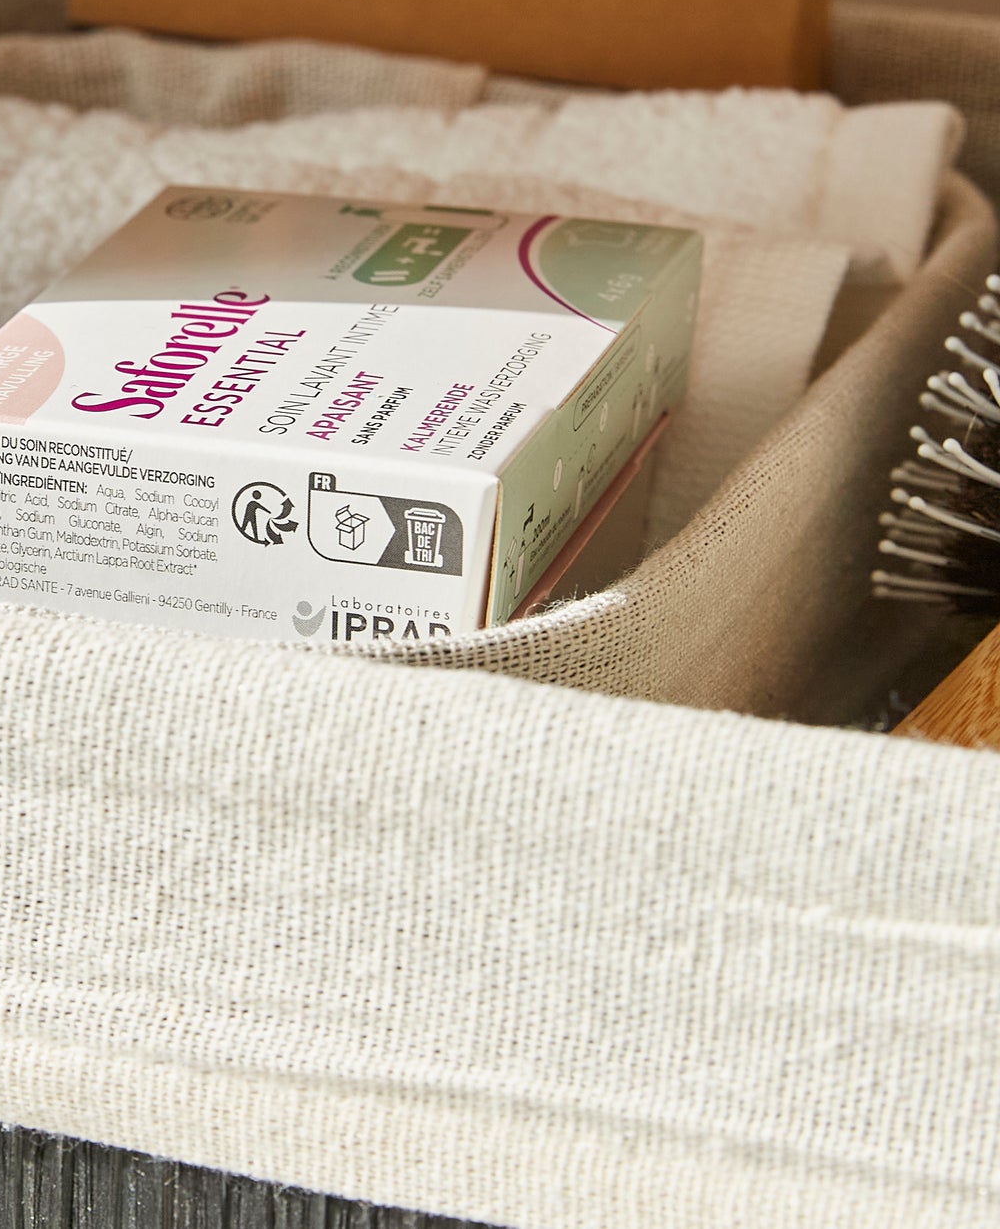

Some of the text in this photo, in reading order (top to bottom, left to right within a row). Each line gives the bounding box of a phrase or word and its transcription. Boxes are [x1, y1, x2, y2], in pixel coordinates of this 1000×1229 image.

[71, 288, 270, 419] Saforelle
[258, 303, 399, 435] SOIN LAVANT INTIME
[180, 329, 307, 427] ESSENTIAL
[430, 332, 552, 456] INTIEME WASVERZORGING
[305, 371, 384, 441] APAISANT
[351, 386, 414, 445] SANS PARFUM
[400, 382, 475, 452] KALMERENDE
[467, 402, 527, 461] ZONDER PARFUM
[2, 436, 18, 449] DU
[20, 438, 46, 452] SOIN
[49, 441, 133, 464] RECONSTITUÉ/
[15, 453, 39, 468] VAN
[41, 457, 57, 470] DE
[58, 459, 137, 480] AANGEVULDE
[139, 468, 215, 489] VERZORGING
[313, 474, 331, 490] FR
[58, 495, 97, 513] Sodium
[105, 501, 140, 519] Citrate,
[148, 507, 219, 527] Alpha-Glucan
[96, 484, 126, 500] Aqua,
[135, 488, 175, 505] Sodium
[184, 494, 219, 512] Cocoyl
[16, 508, 55, 525] Sodium
[69, 514, 122, 534] Gluconate,
[136, 524, 164, 539] Algin,
[178, 527, 219, 544] Sodium
[414, 521, 435, 536] BAC
[417, 535, 431, 549] DE
[54, 547, 94, 564] Arctium
[96, 553, 128, 569] Lappa
[130, 556, 155, 571] Root
[56, 530, 120, 550] Maltodextrin,
[122, 538, 174, 556] Potassium
[176, 544, 218, 562] Sorbate,
[416, 548, 432, 562] TRI
[66, 583, 73, 596] 7
[74, 586, 112, 601] avenue
[113, 589, 150, 605] Gallieni
[158, 594, 193, 611] 94250
[194, 599, 233, 617] Gentilly
[241, 604, 278, 621] France
[331, 595, 450, 620] Laboratoires
